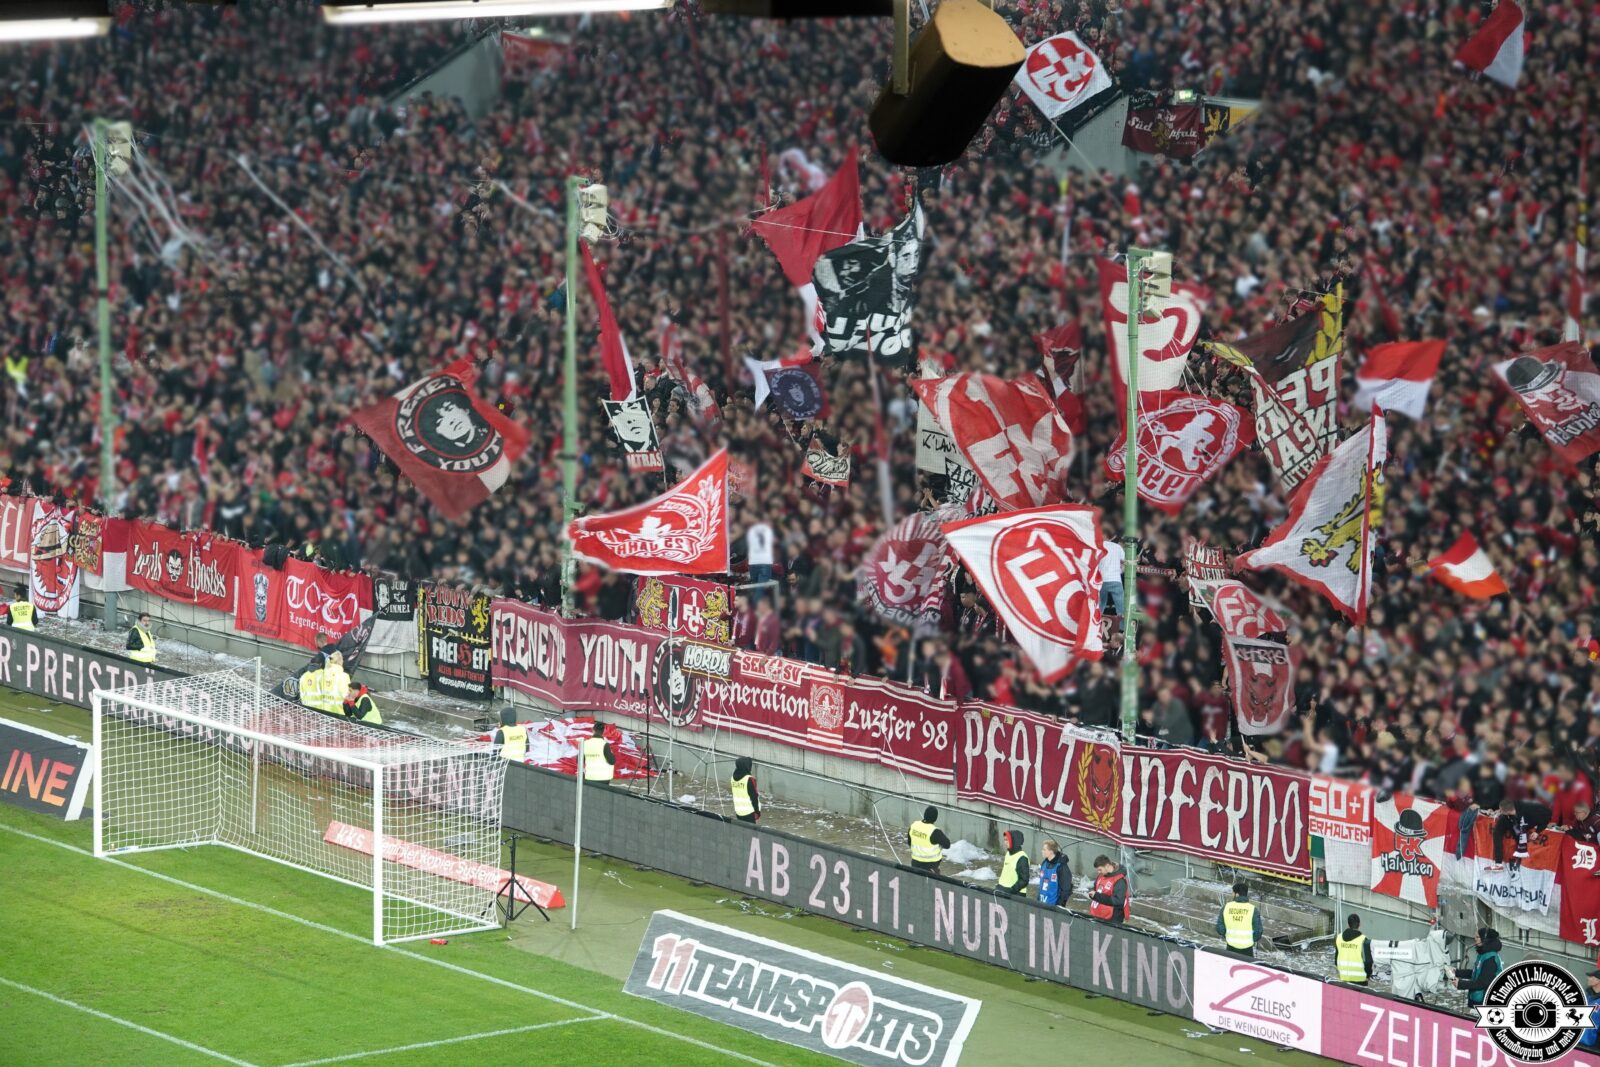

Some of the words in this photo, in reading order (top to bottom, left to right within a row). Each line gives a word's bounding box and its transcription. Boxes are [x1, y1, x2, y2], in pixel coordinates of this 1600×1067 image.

[579, 632, 648, 695] YOUTH
[683, 644, 731, 677] HORDA
[843, 701, 916, 742] Luzifer
[963, 710, 1077, 816] PFALZ
[1120, 754, 1304, 865] INFERNO
[1309, 818, 1370, 845] ERHALTEN
[1381, 851, 1434, 879] Halunken
[745, 836, 791, 897] AB
[809, 853, 915, 935] 23.11.
[934, 887, 1009, 961] NUR
[1028, 913, 1071, 979] IM
[1091, 929, 1188, 1010] KINO
[1228, 907, 1250, 916] SECURITY
[1340, 942, 1359, 951] SECURITY
[1218, 1015, 1232, 1028] DIE
[1233, 1018, 1292, 1044] WEINLOUNGE
